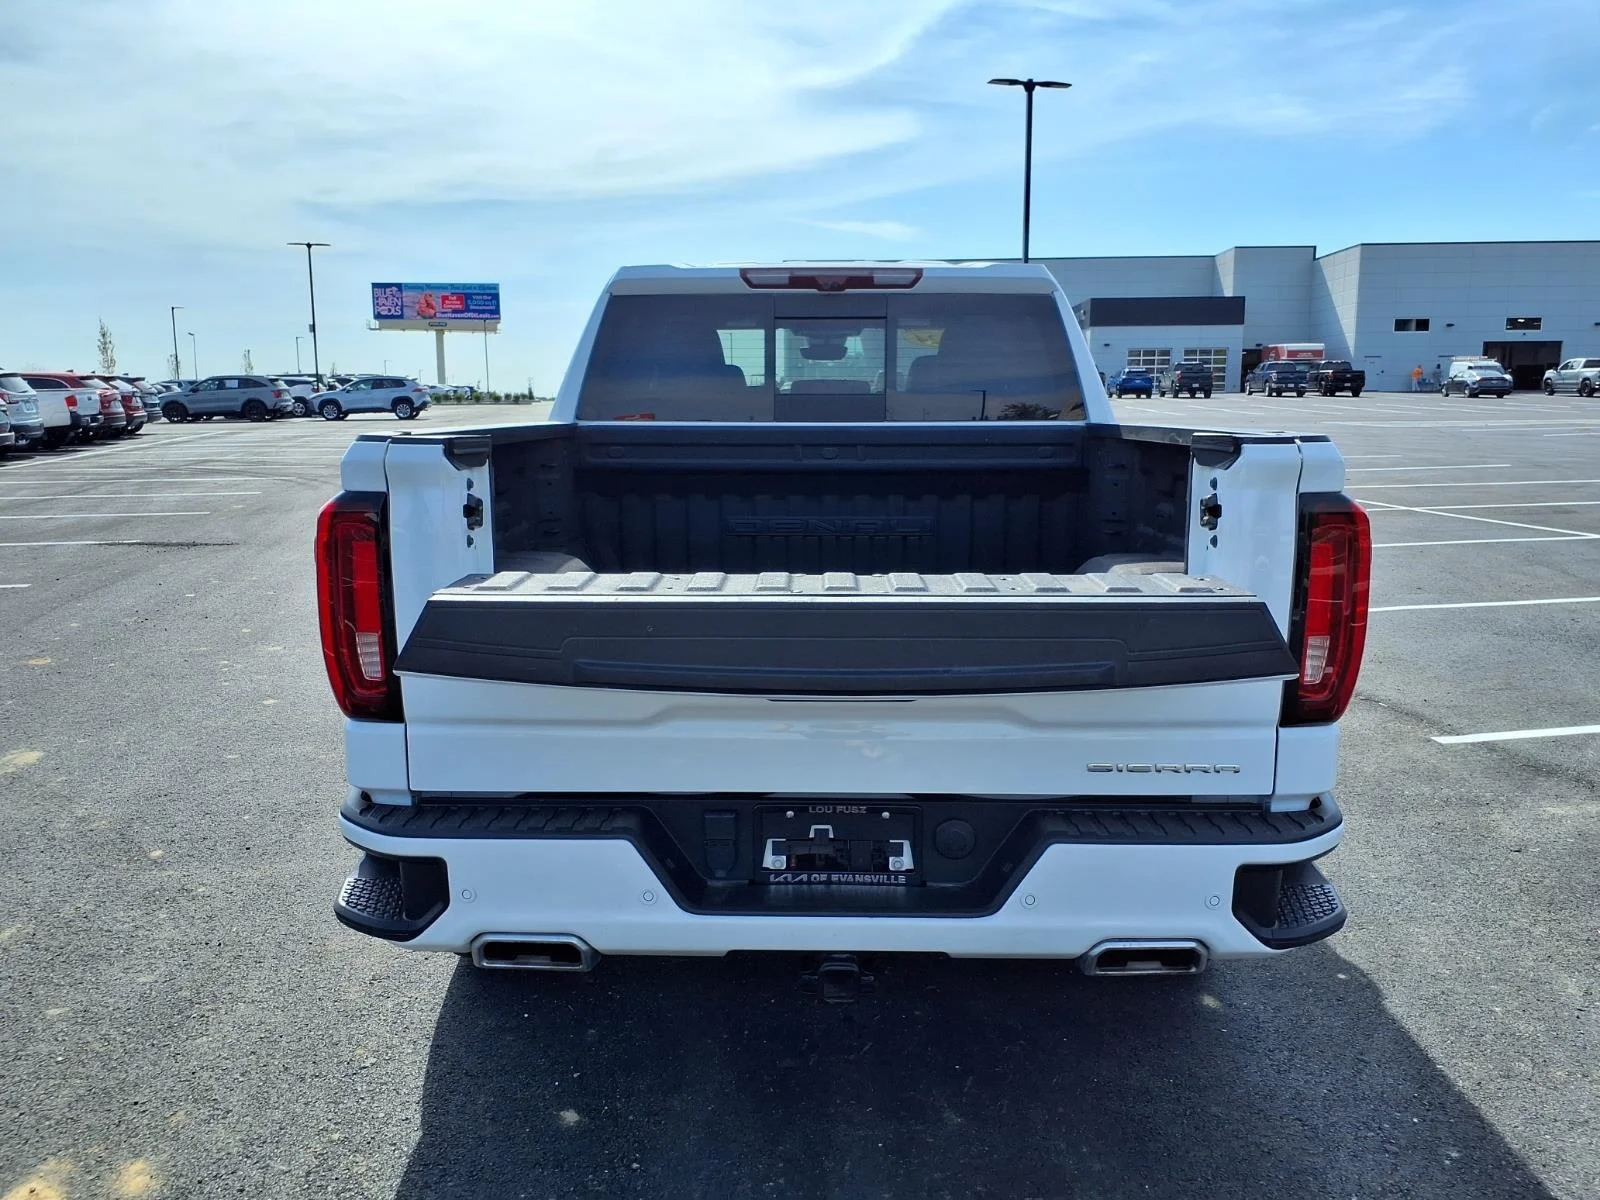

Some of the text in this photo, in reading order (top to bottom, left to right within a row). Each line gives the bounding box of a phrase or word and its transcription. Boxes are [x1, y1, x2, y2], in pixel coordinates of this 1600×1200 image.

[374, 287, 394, 297] BLUE
[374, 297, 401, 306] HAVEN
[375, 306, 401, 315] POOLS
[1087, 763, 1241, 774] SIERRA
[808, 805, 867, 814] LOU FUSZ
[770, 873, 907, 884] KIA OF EVANSVILLE
